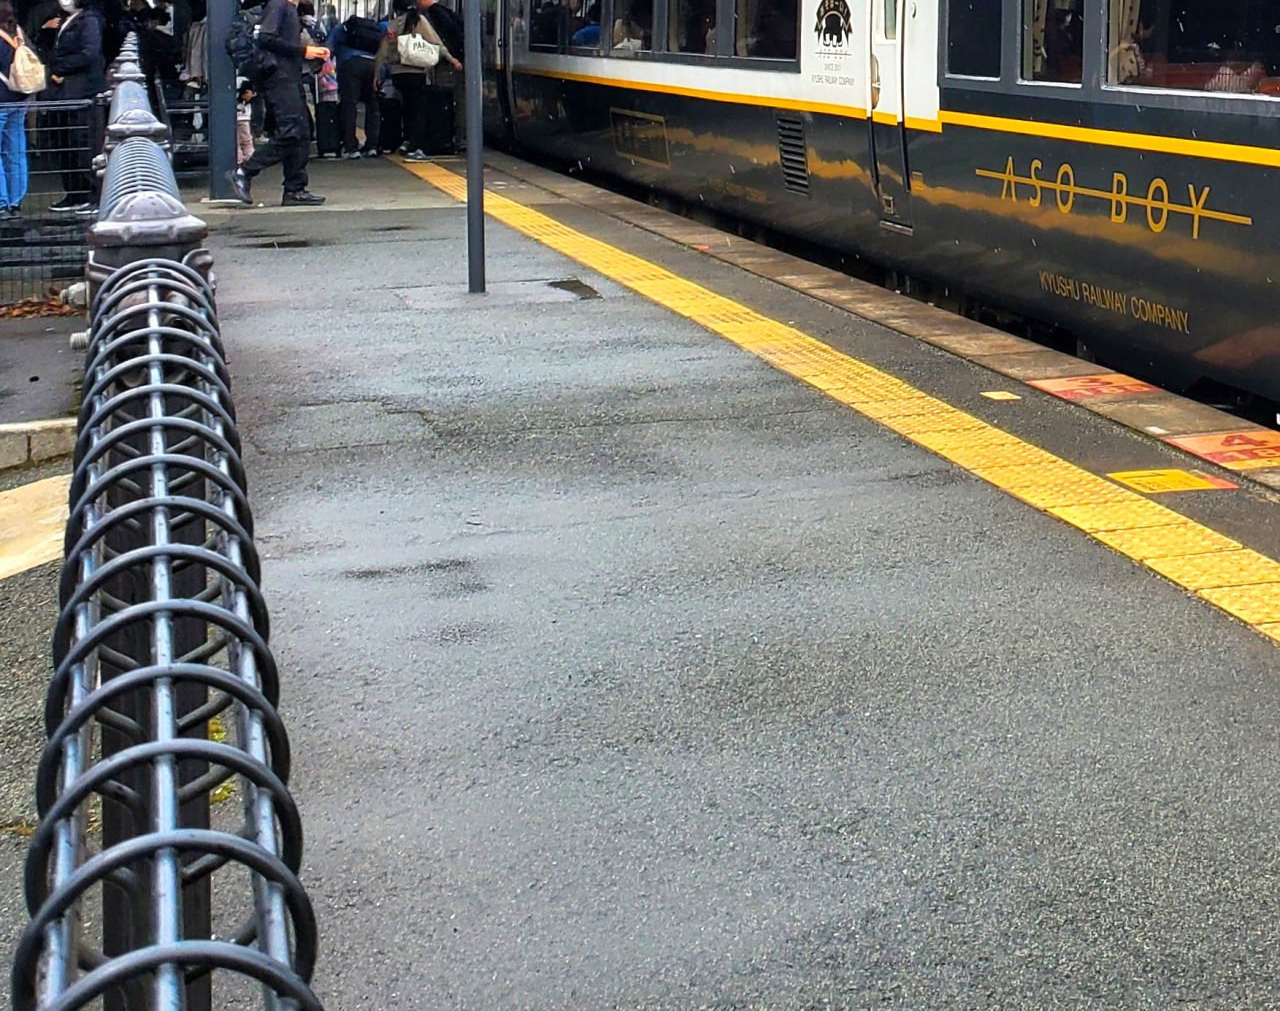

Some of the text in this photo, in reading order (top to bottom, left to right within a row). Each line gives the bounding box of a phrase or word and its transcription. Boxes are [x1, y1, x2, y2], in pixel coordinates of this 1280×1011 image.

[1000, 155, 1211, 239] ASO BOY
[1039, 270, 1190, 333] KYUSHU RAILWAY COMPANY
[1220, 434, 1270, 448] 4
